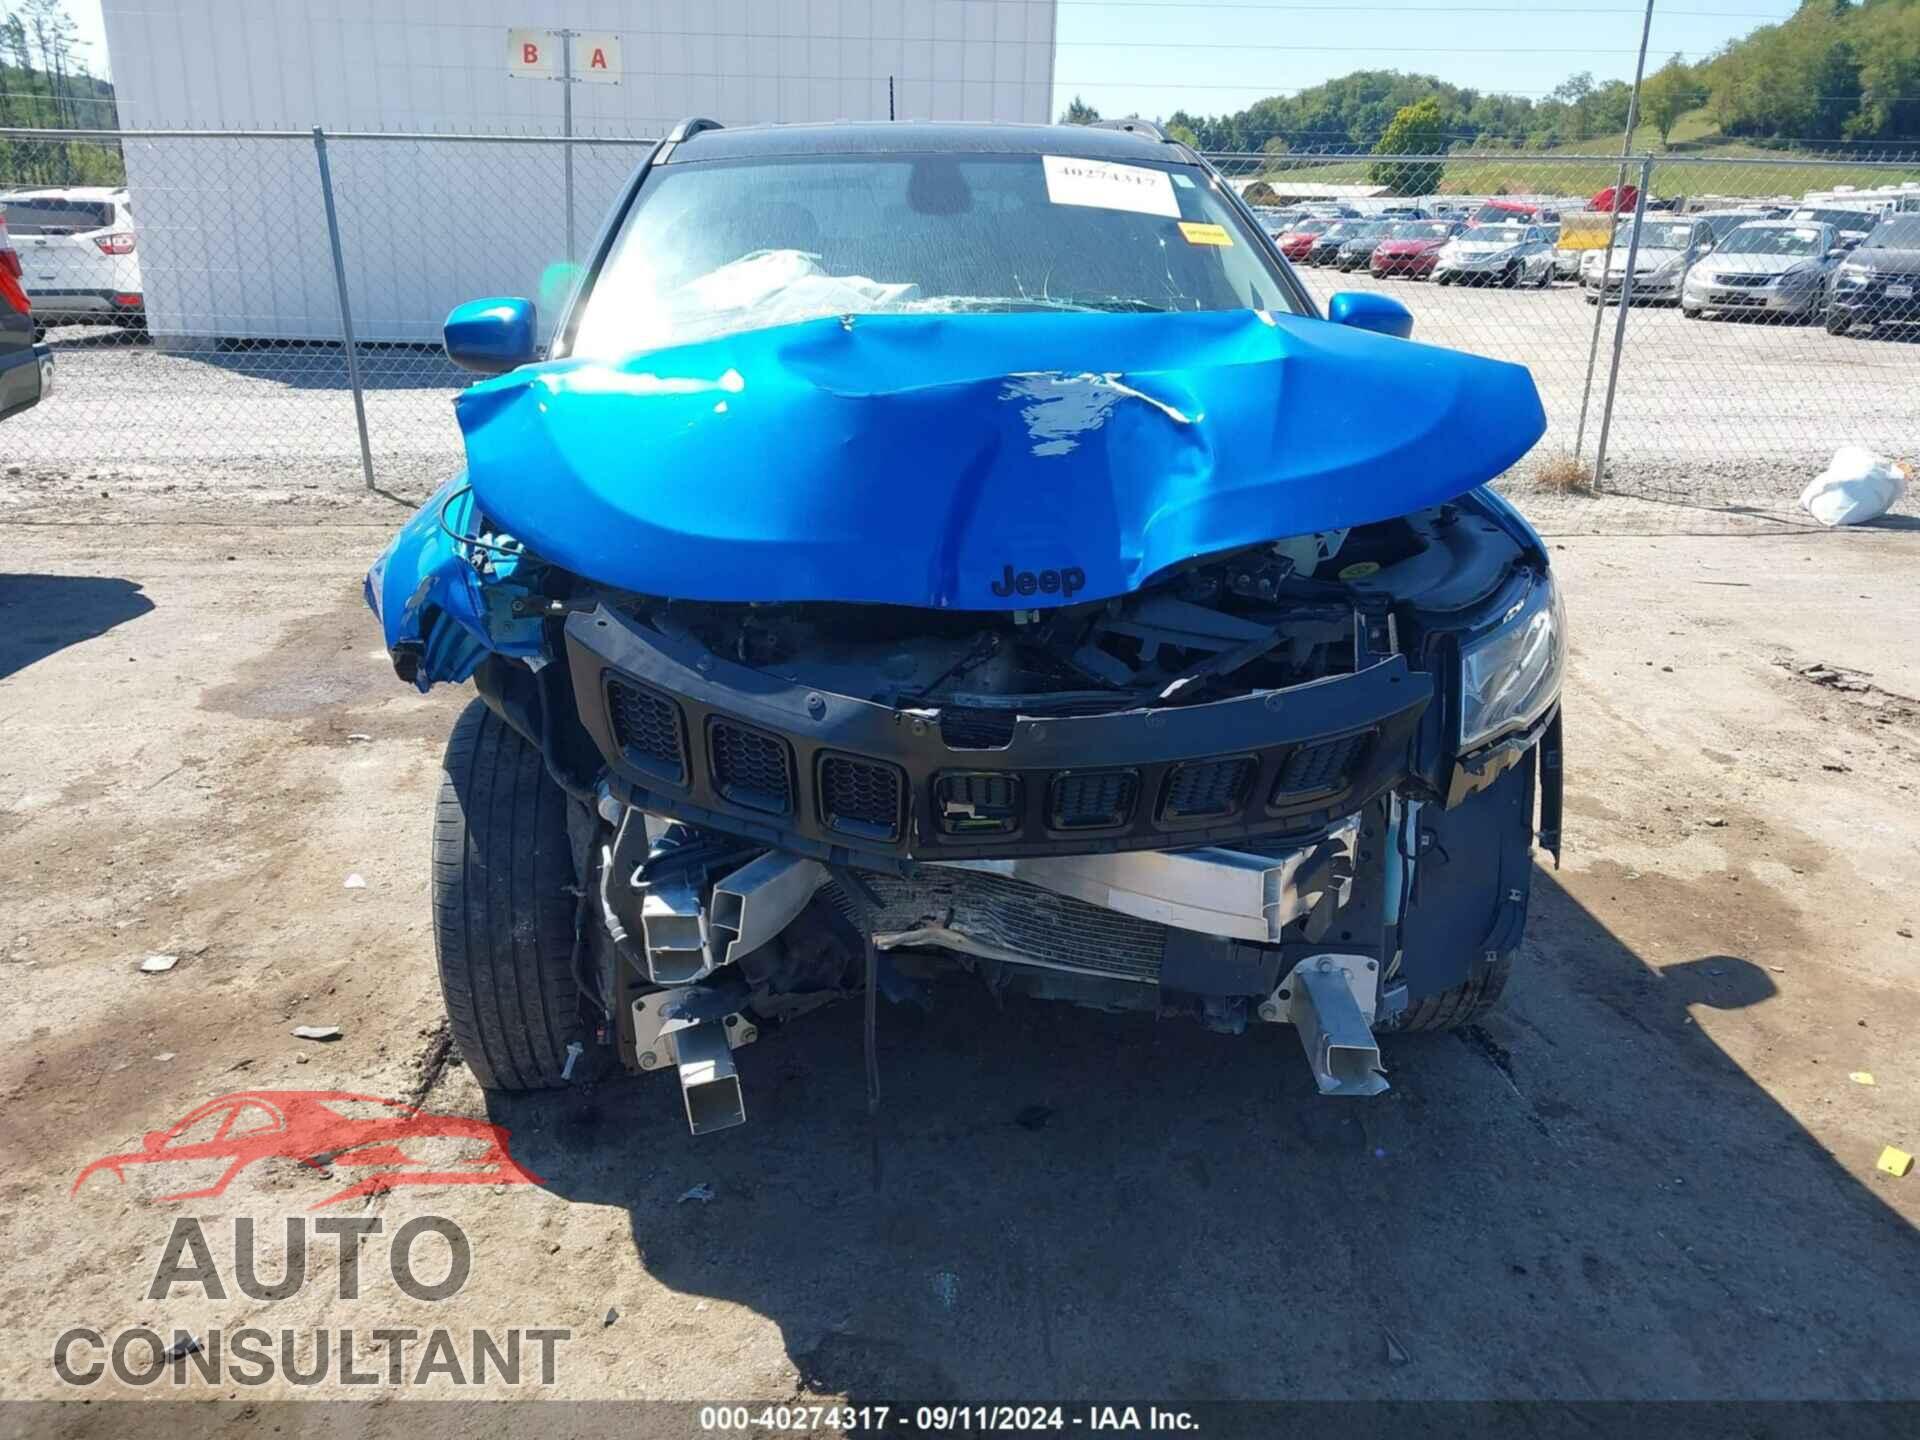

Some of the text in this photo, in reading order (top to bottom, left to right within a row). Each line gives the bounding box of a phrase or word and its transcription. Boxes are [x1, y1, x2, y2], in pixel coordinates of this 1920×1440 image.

[523, 44, 538, 64] B
[591, 49, 606, 68] A
[991, 564, 1086, 598] Jeep
